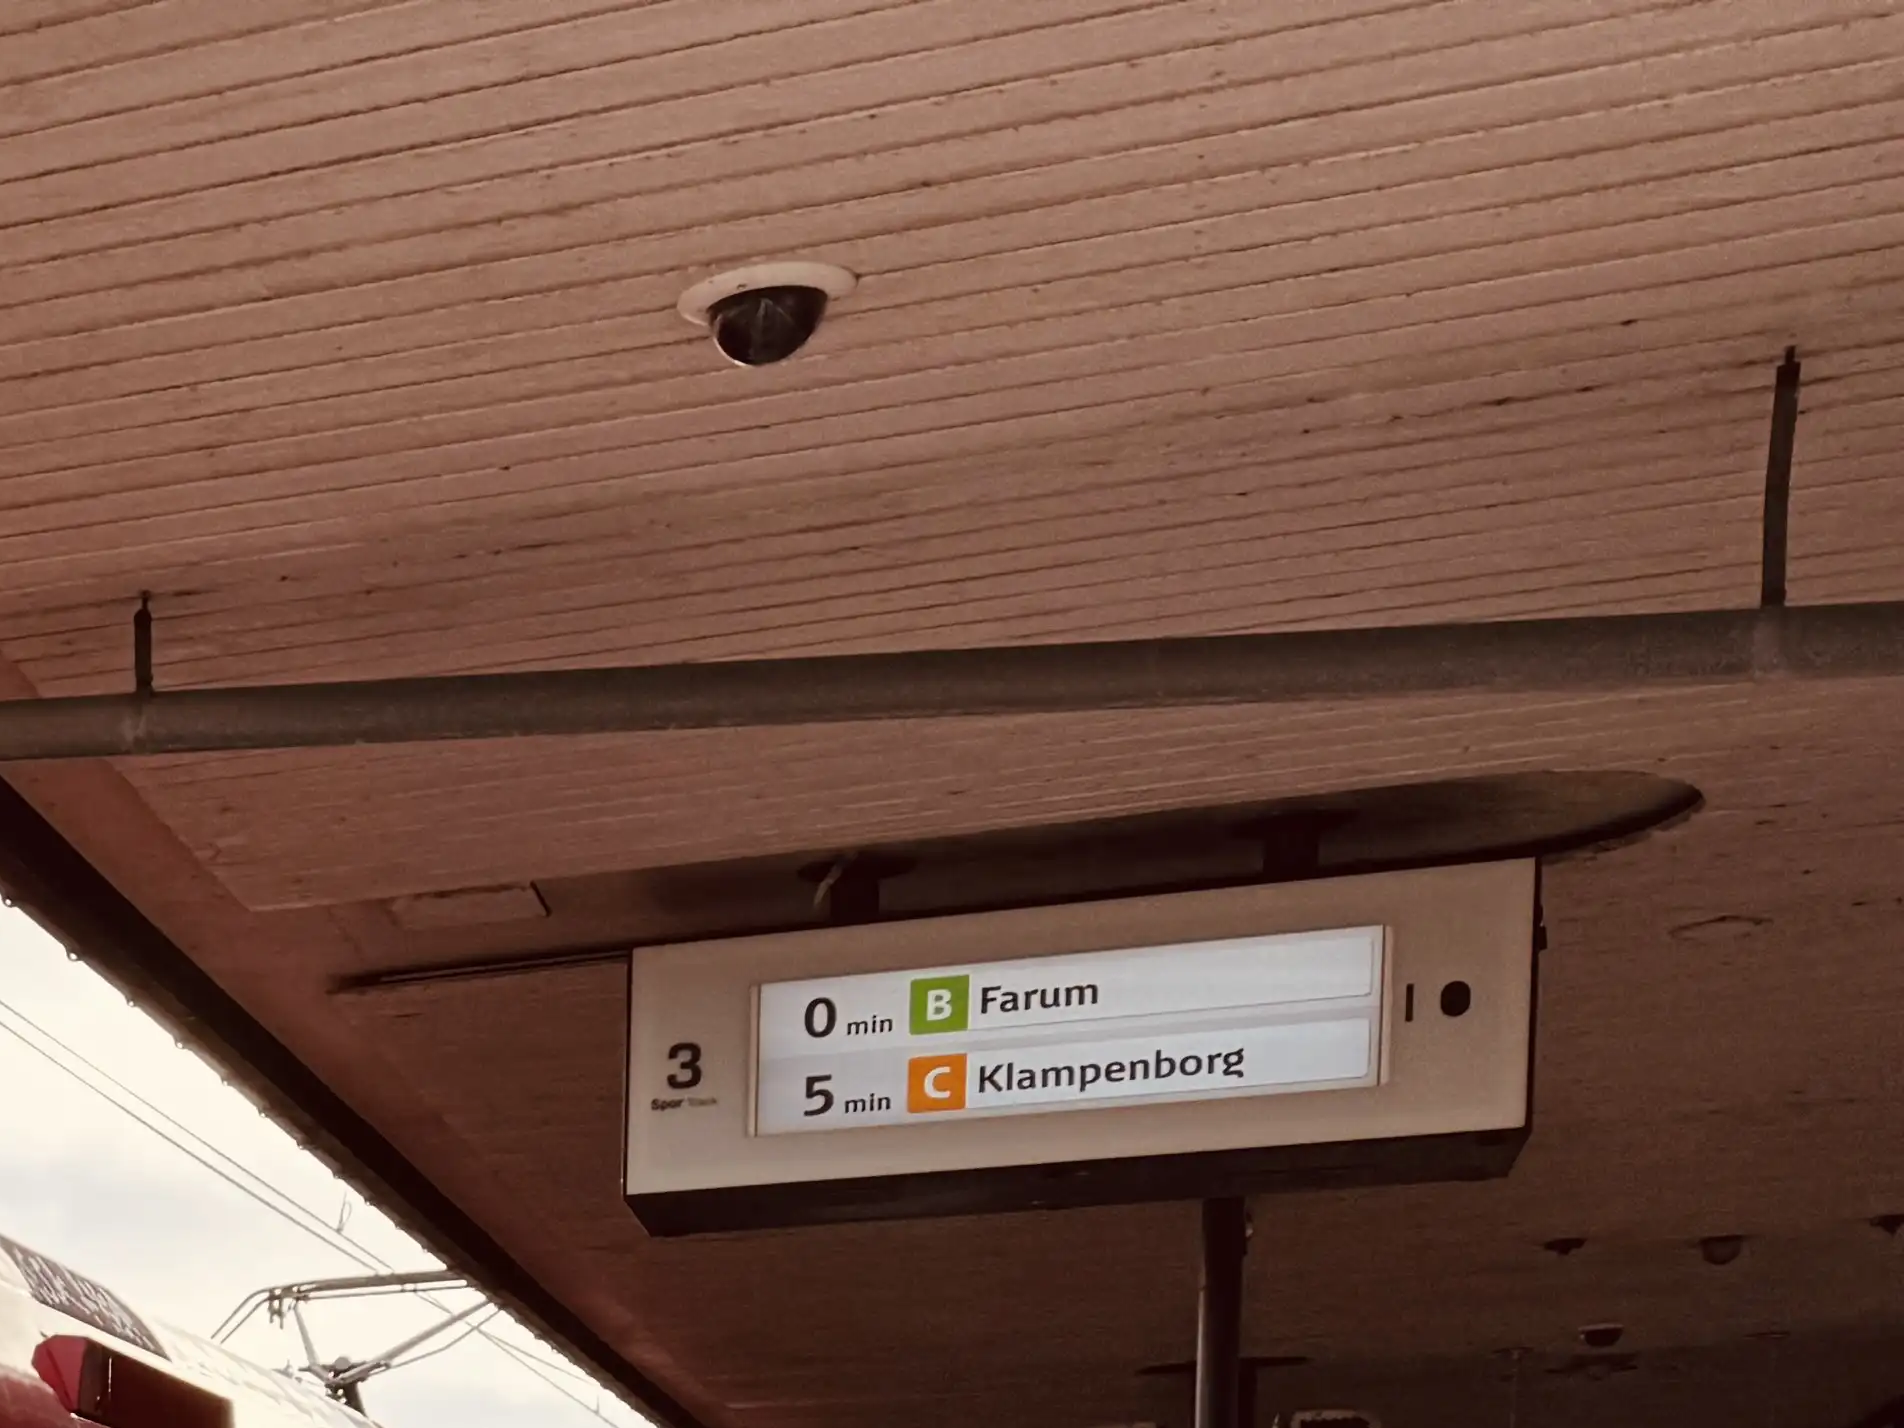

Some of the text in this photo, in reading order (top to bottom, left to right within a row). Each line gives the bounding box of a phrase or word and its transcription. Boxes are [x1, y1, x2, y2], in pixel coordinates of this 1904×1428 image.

[804, 983, 1098, 1038] 0 min B Farum
[666, 1042, 702, 1089] 3
[803, 1048, 1245, 1117] 5 min C Klampenborg
